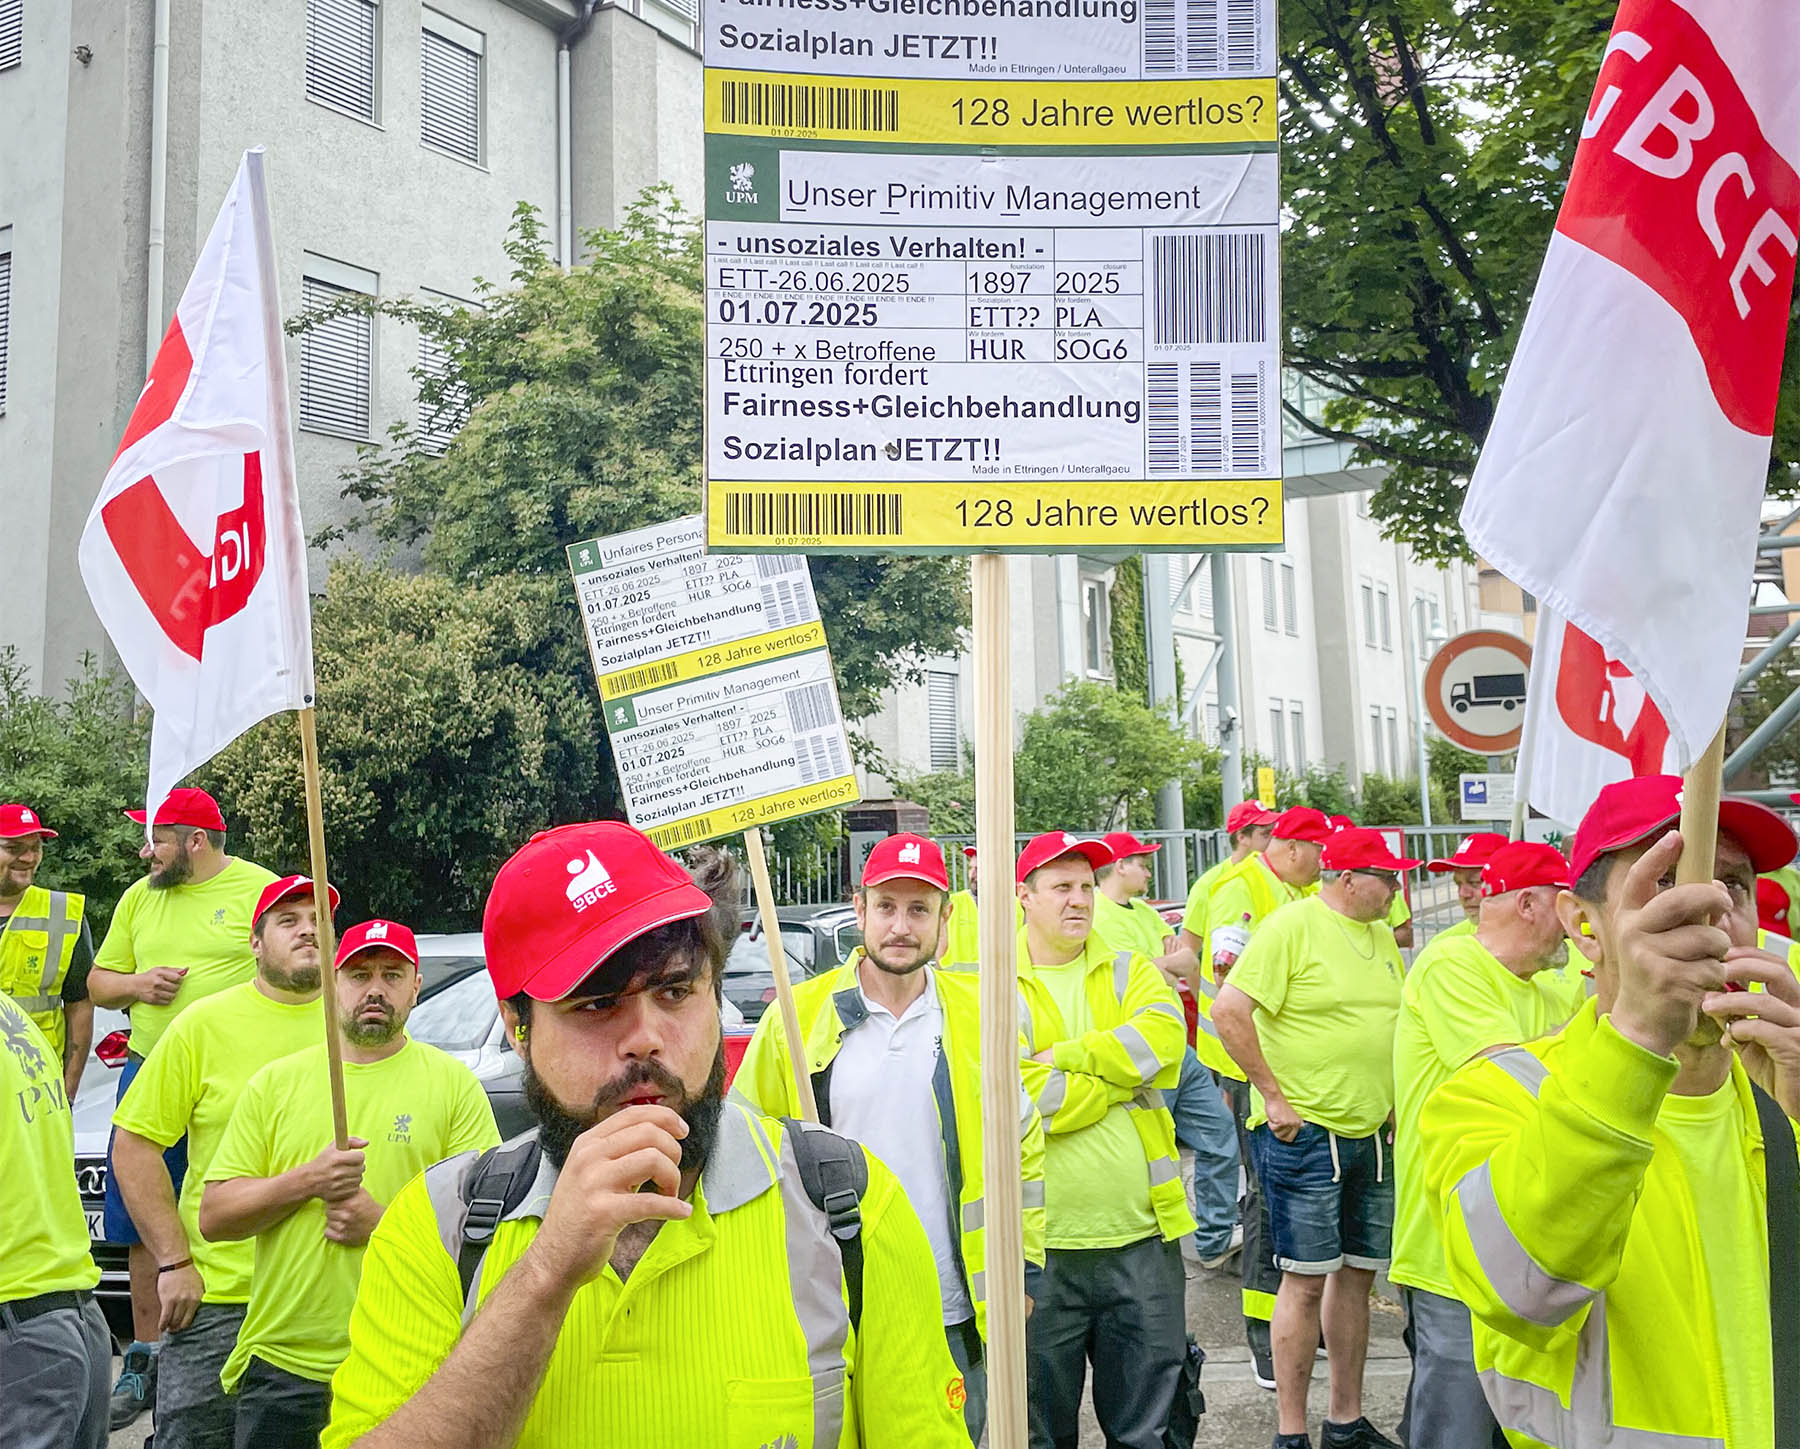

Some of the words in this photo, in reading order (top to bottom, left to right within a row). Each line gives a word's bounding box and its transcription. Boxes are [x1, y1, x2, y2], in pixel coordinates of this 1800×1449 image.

[719, 24, 873, 60] Sozialplan
[884, 34, 997, 60] JETZT!!
[969, 64, 996, 73] Made
[999, 64, 1008, 73] in
[1011, 64, 1055, 75] Ettringen
[1064, 65, 1127, 75] Unterallgaeu
[951, 98, 1010, 126] 128
[1022, 98, 1113, 126] Jahre
[1125, 95, 1264, 126] wertlos?
[725, 191, 759, 204] UPM
[788, 179, 877, 209] Unser
[887, 183, 995, 210] Primitiv
[1006, 185, 1200, 217] Management
[737, 234, 881, 257] unsoziales
[889, 235, 1026, 258] Verhalten!
[719, 267, 910, 293] ETT-26.06.2025
[969, 272, 1031, 293] 1897
[1055, 272, 1119, 293] 2025
[719, 299, 878, 326] 01.07.2025
[970, 306, 1040, 328] ETT??
[1056, 307, 1103, 328] PLA
[719, 337, 763, 358] 250
[772, 342, 786, 356] +
[794, 344, 807, 359] x
[816, 339, 936, 361] Betroffene
[970, 339, 1026, 360] HUR
[1056, 339, 1128, 360] SOG6
[723, 360, 833, 388] Ettringen
[845, 362, 929, 386] fordert
[723, 392, 1140, 424] Fairness+Gleichbehandlung
[723, 436, 876, 467] Sozialplan
[887, 438, 1000, 462] JETZT!!
[972, 465, 1000, 474] Made
[1002, 465, 1011, 474] in
[1014, 465, 1058, 476] Ettringen
[1067, 465, 1130, 476] Unterallgaeu
[955, 499, 1014, 527] 128
[1026, 499, 1118, 527] Jahre
[1130, 496, 1269, 527] wertlos?
[603, 541, 654, 561] Unfaires
[588, 565, 646, 585] unsoziales
[648, 549, 703, 570] Verhalten!
[683, 562, 707, 577] 1897
[717, 555, 743, 569] 2025
[719, 570, 740, 581] PLA
[587, 590, 651, 614] 01.07.2025
[688, 590, 712, 602] HUR
[722, 579, 752, 594] SOG6
[594, 619, 639, 637] Ettringen
[596, 601, 762, 650] Fairness+Gleichbehandlung
[601, 644, 663, 667] Sozialplan
[666, 630, 711, 651] JETZT!!
[698, 652, 722, 668] 128
[726, 644, 762, 661] Jahre
[765, 628, 819, 651] wertlos?
[638, 702, 674, 719] Unser
[676, 690, 720, 708] Primitiv
[723, 670, 800, 697] Management
[623, 723, 680, 743] unsoziales
[682, 706, 737, 726] Verhalten!
[718, 718, 742, 733] 1897
[750, 710, 777, 724] 2025
[753, 726, 773, 737] PLA
[622, 747, 685, 772] 01.07.2025
[722, 745, 745, 759] HUR
[756, 735, 786, 750] SOG6
[628, 776, 673, 795] Ettringen
[631, 757, 796, 807] Fairness+Gleichbehandlung
[635, 800, 697, 824] Sozialplan
[700, 786, 745, 806] JETZT!!
[731, 807, 756, 824] 128
[760, 801, 796, 817] Jahre
[798, 782, 852, 806] wertlos?
[16, 1078, 65, 1124] UPM
